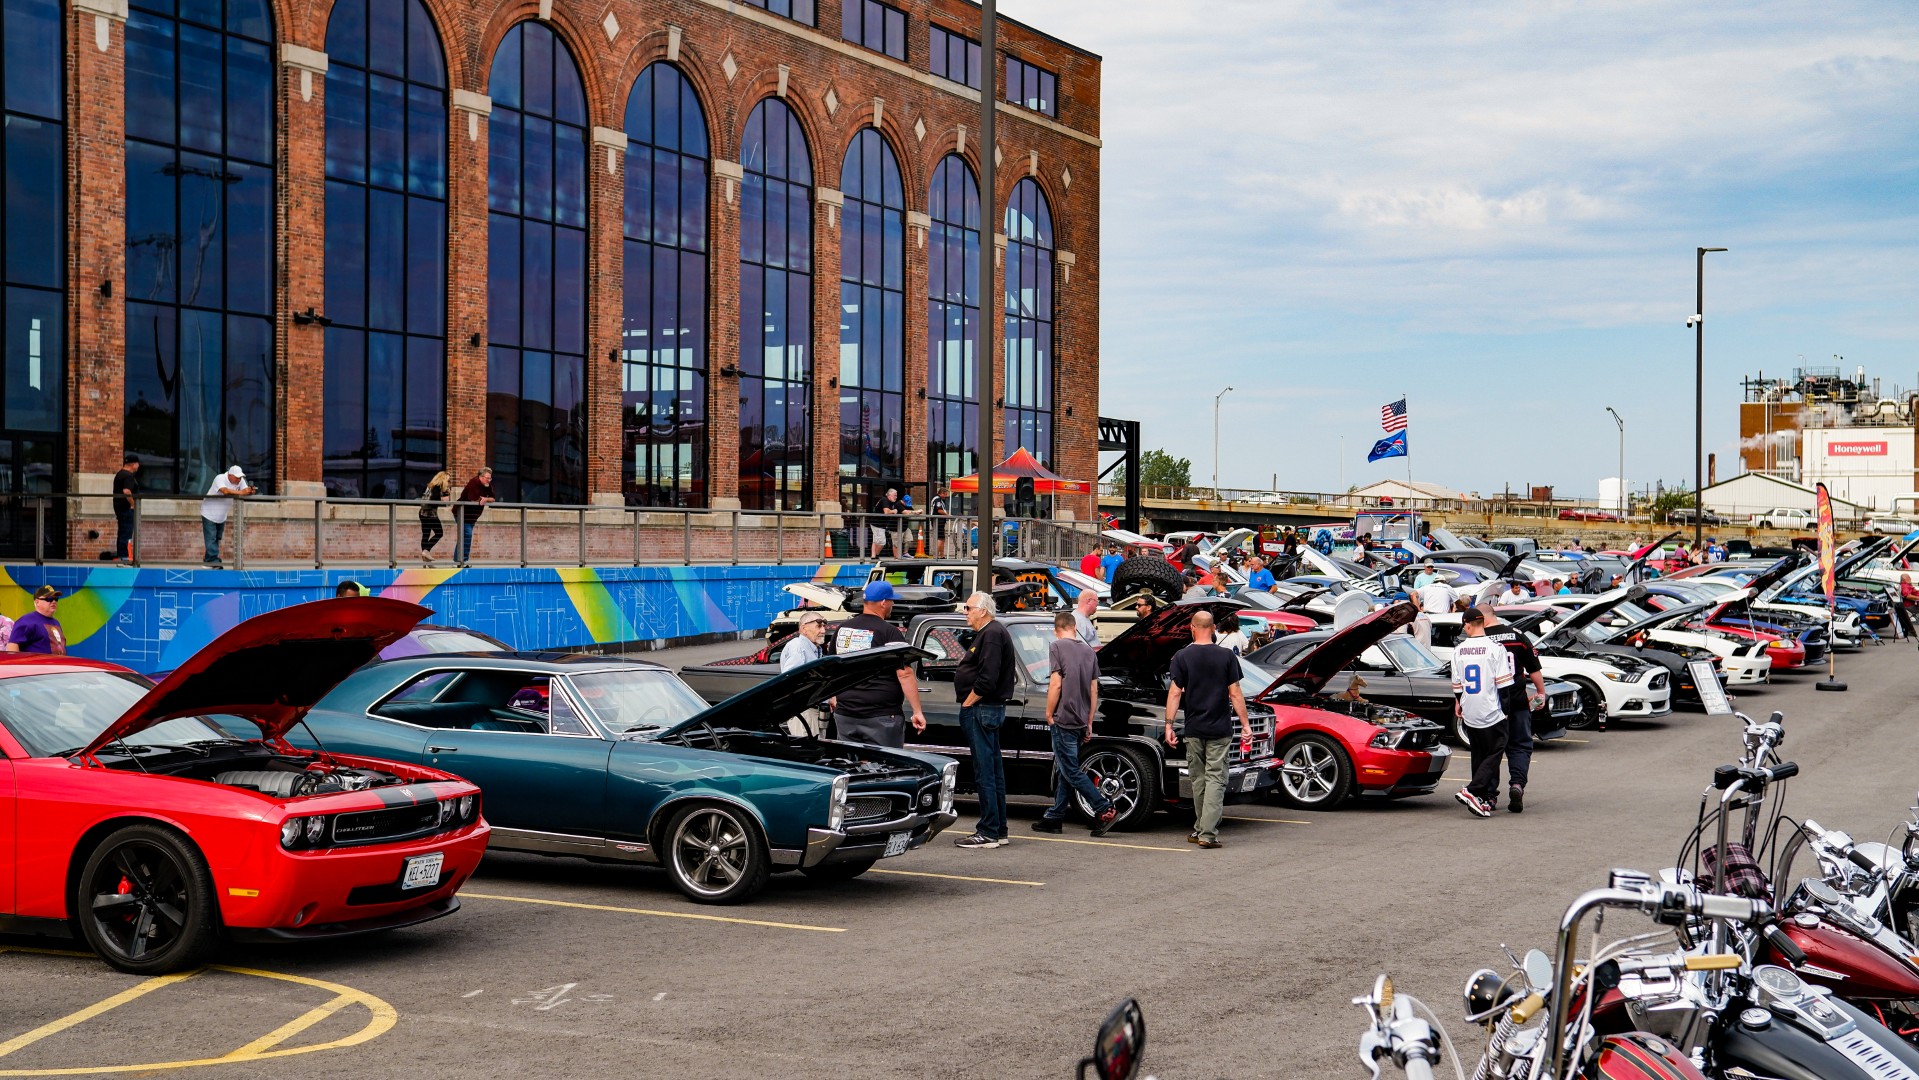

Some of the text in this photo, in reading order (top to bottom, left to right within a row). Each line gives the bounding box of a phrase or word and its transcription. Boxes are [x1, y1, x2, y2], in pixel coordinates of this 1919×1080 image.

[1834, 445, 1881, 455] Honeywell
[1460, 647, 1487, 655] BOUCHER
[1465, 664, 1481, 694] 9
[336, 825, 375, 833] CHALLENGER
